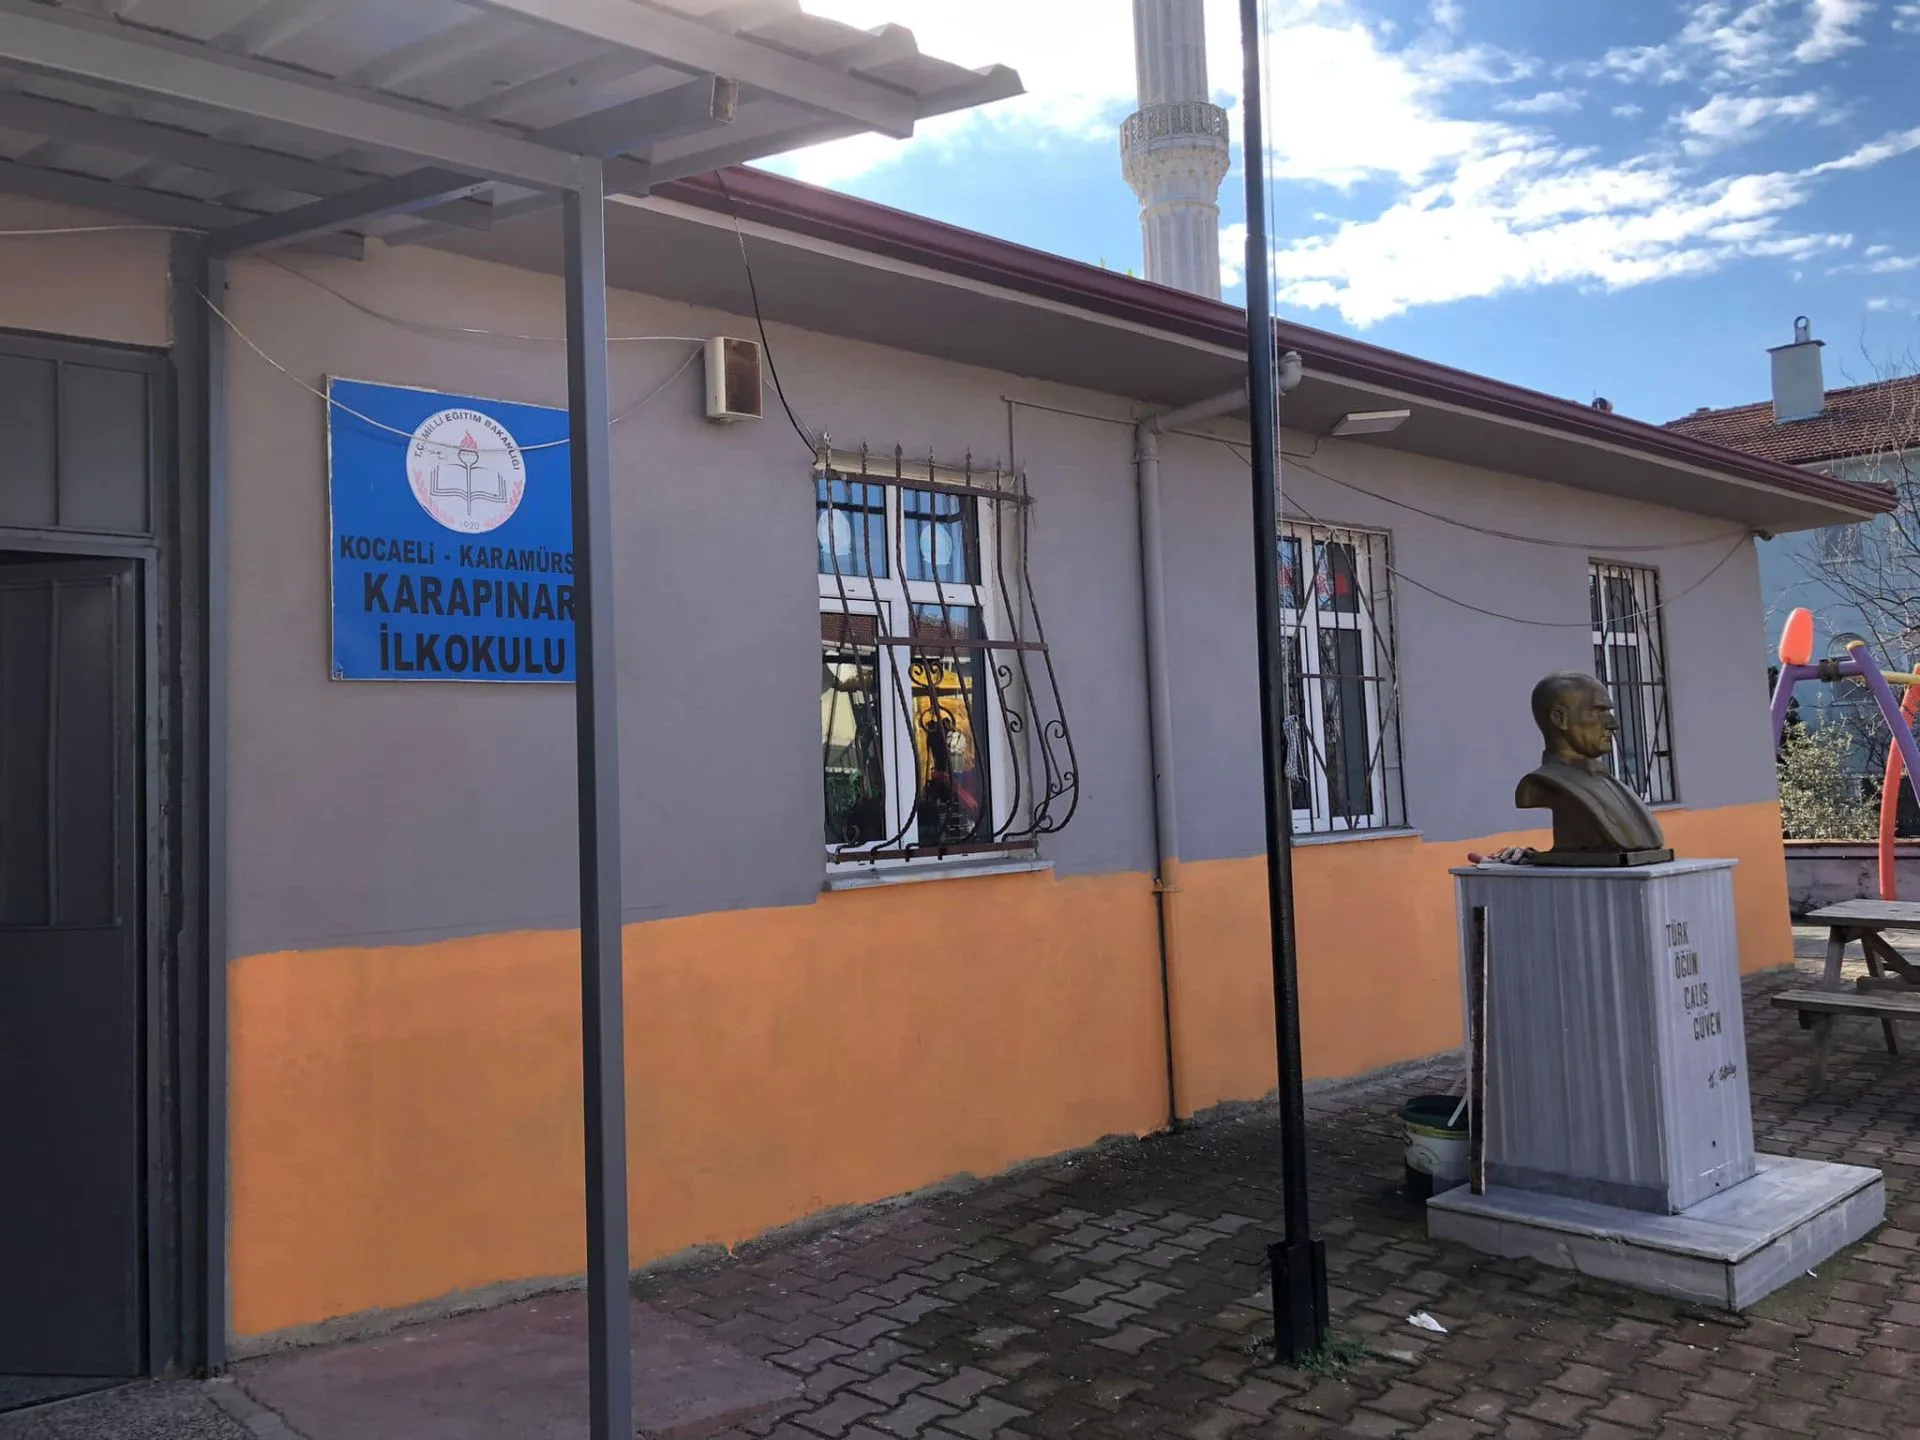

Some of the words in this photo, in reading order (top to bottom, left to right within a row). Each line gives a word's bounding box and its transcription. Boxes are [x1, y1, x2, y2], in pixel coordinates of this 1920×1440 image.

[363, 572, 576, 621] KARAPINAR
[379, 622, 565, 673] İLKOKULU
[1665, 919, 1689, 948] TÜRK
[1674, 949, 1698, 979] ÖĞÜN
[1683, 982, 1709, 1015] ÇALIŞ
[1693, 1011, 1721, 1041] GÜVEN
